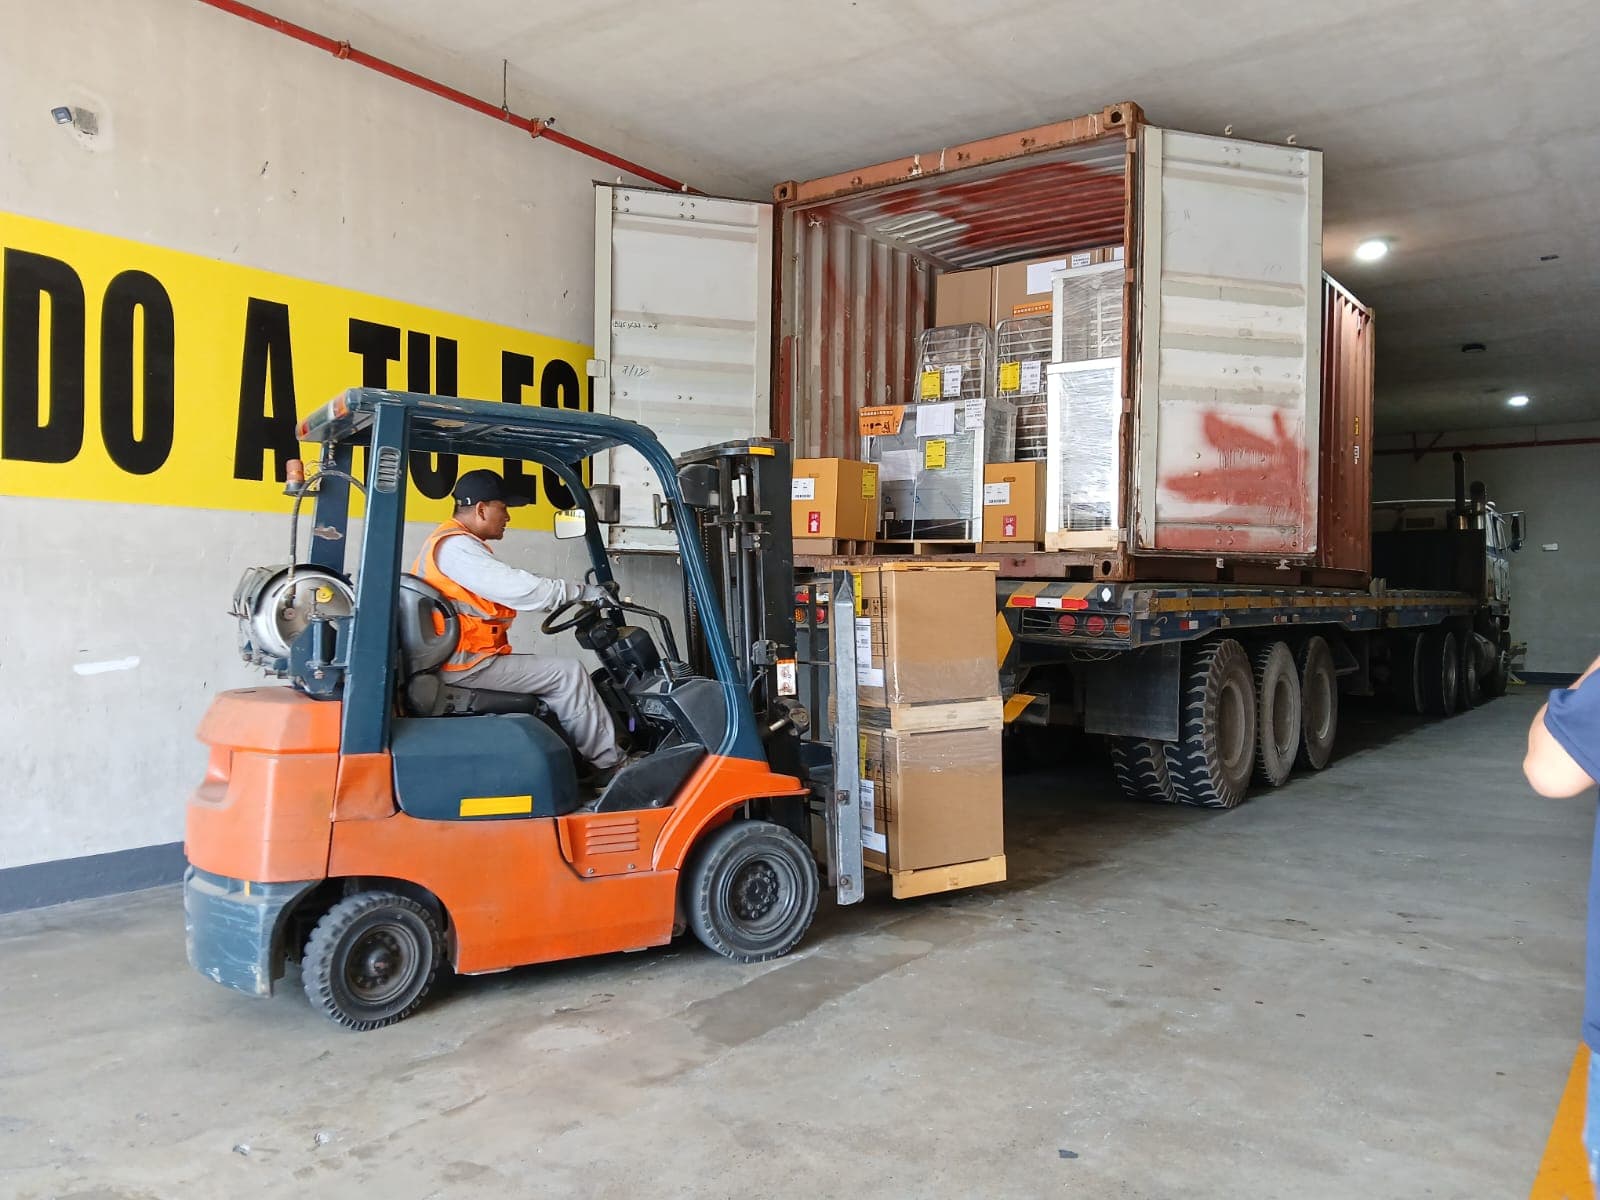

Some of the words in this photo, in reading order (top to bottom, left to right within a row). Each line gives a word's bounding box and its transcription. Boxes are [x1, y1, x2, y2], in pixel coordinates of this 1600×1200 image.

[1, 246, 175, 476] DO
[233, 296, 301, 485] A
[348, 317, 458, 500] TU
[502, 350, 594, 511] ES
